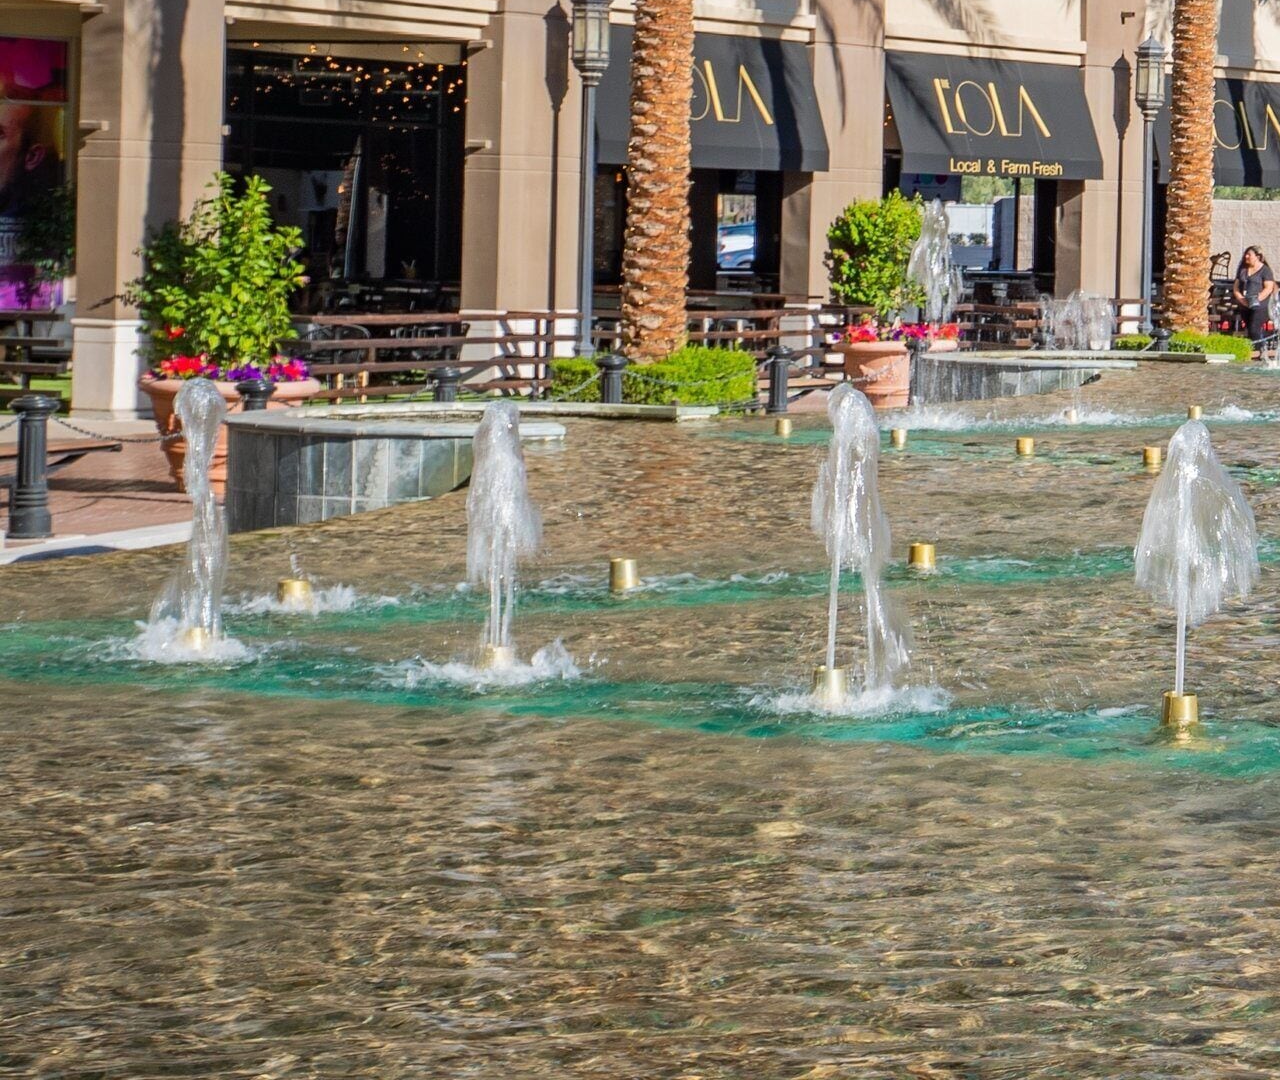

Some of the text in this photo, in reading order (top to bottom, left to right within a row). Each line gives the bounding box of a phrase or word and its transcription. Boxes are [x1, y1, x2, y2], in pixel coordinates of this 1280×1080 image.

[933, 78, 1051, 138] LOLA
[950, 156, 1064, 177] Local & Farm Fresh
